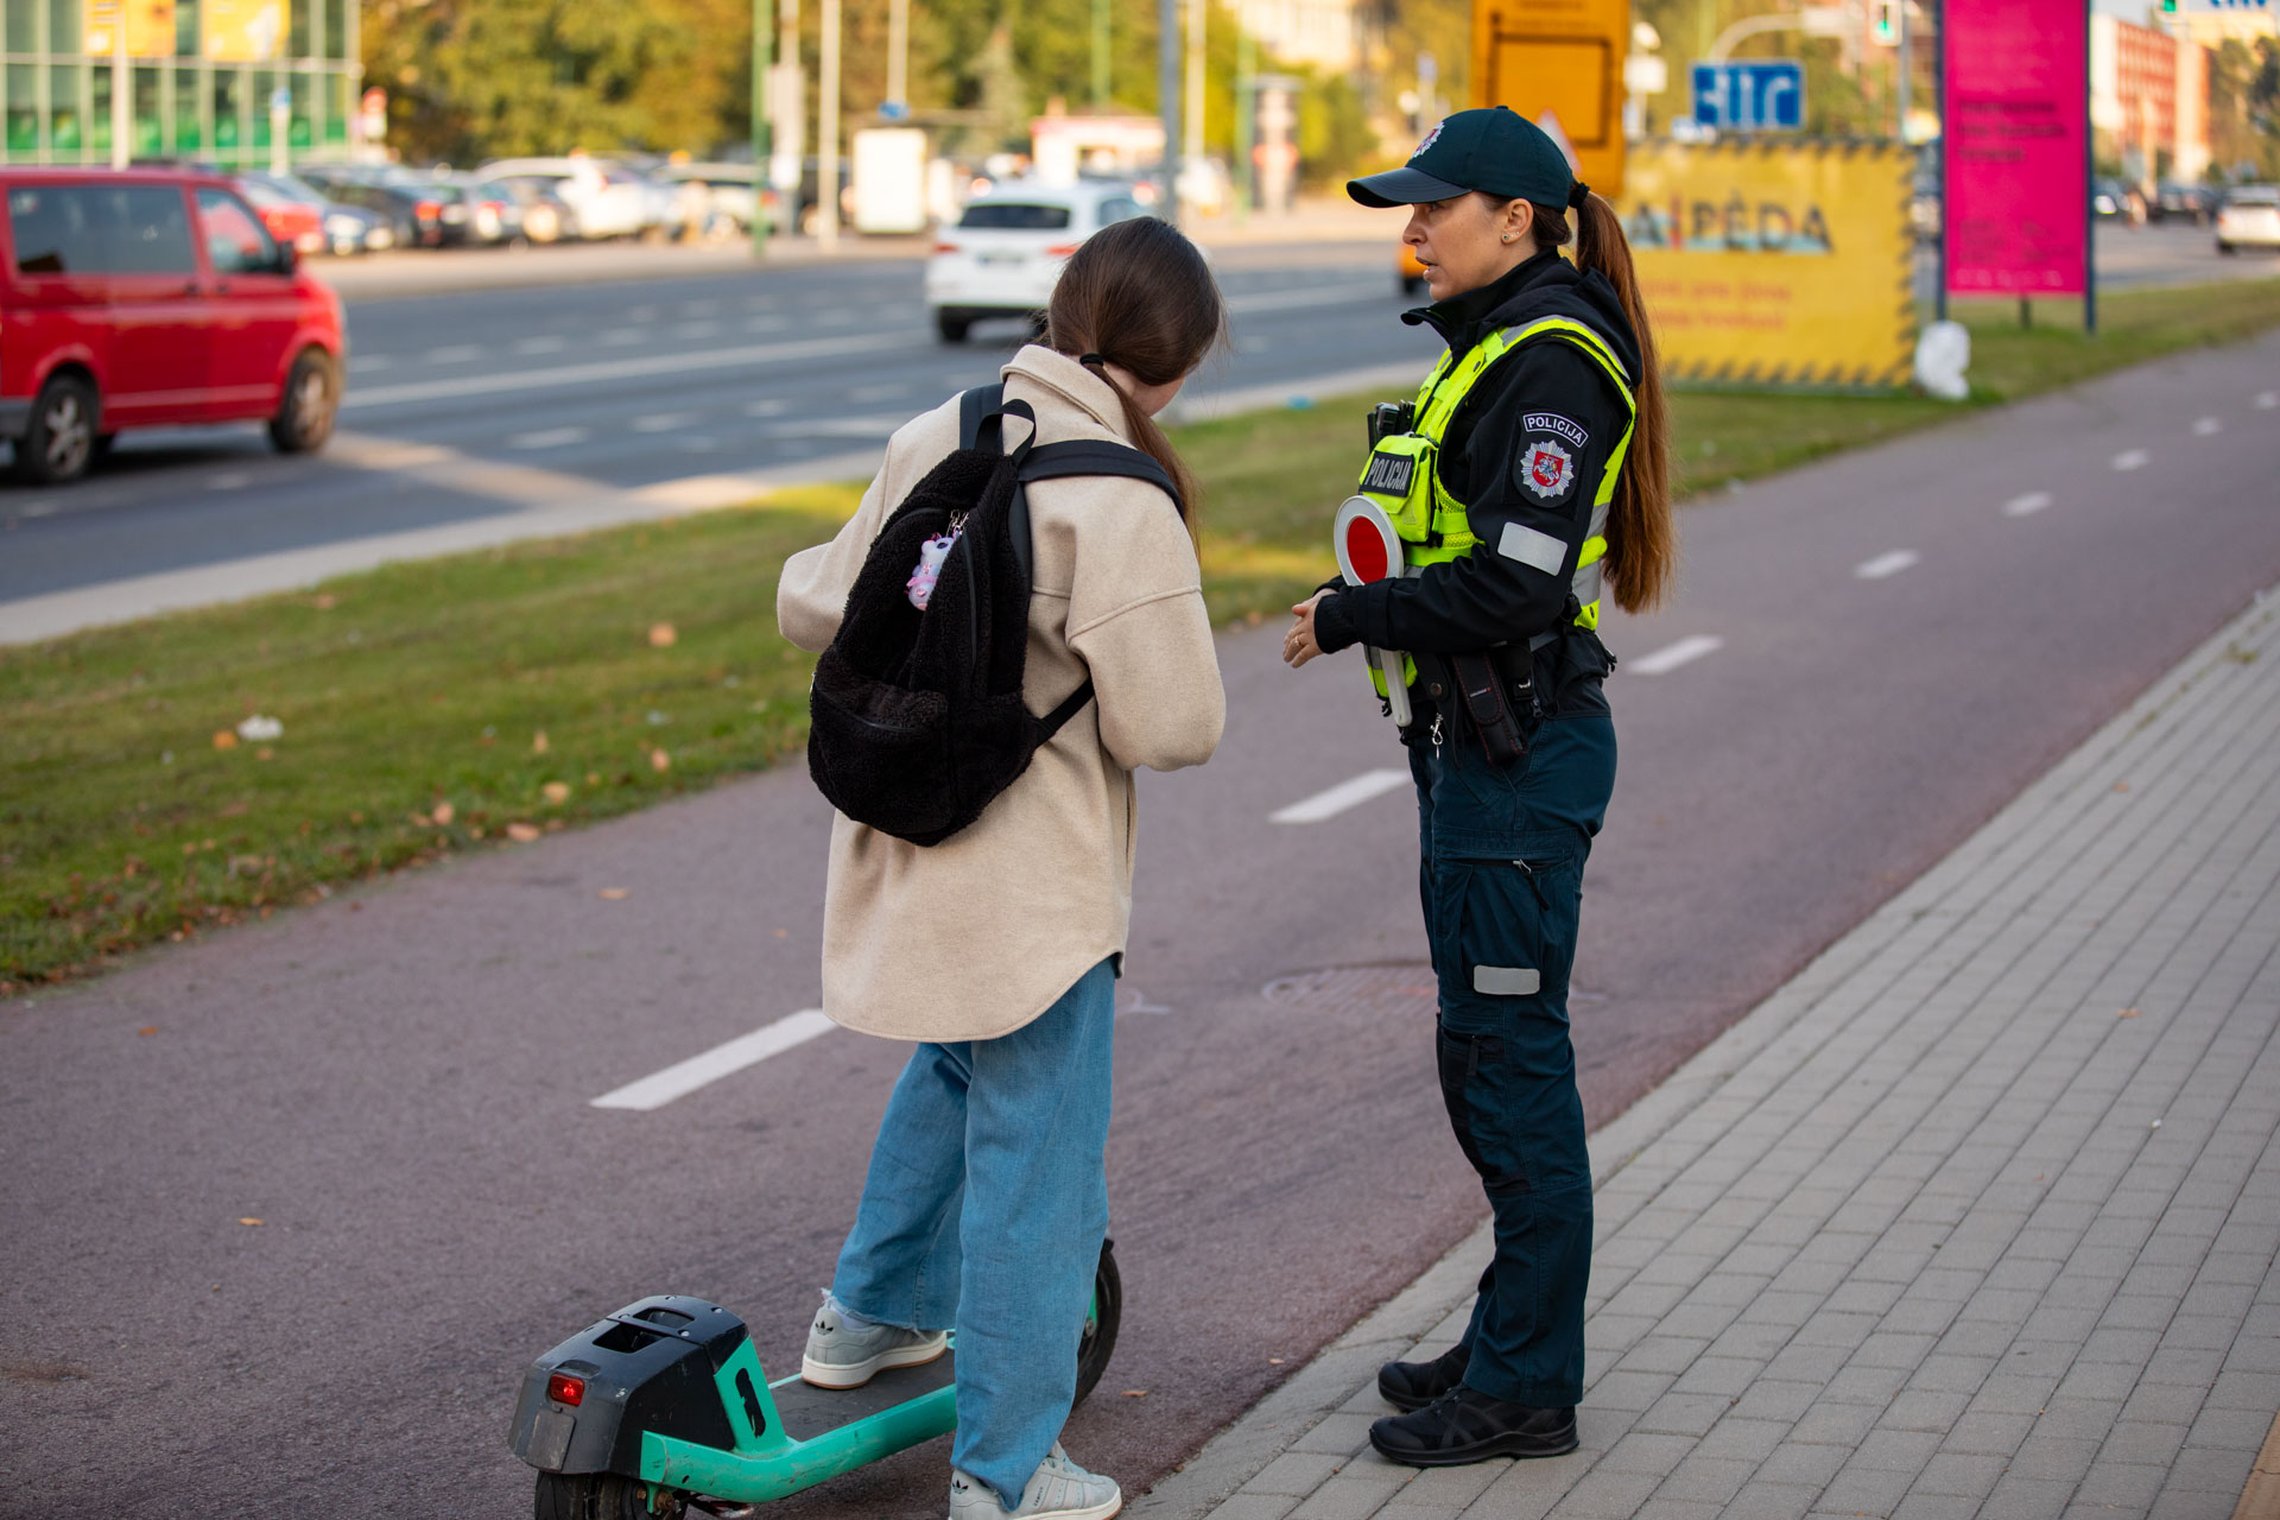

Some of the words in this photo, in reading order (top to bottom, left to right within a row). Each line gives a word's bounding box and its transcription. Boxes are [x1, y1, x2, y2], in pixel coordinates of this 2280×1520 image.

[1628, 189, 1835, 253] AIPĖDA
[1527, 416, 1583, 444] POLICIJA
[1364, 458, 1412, 490] POLICIJA
